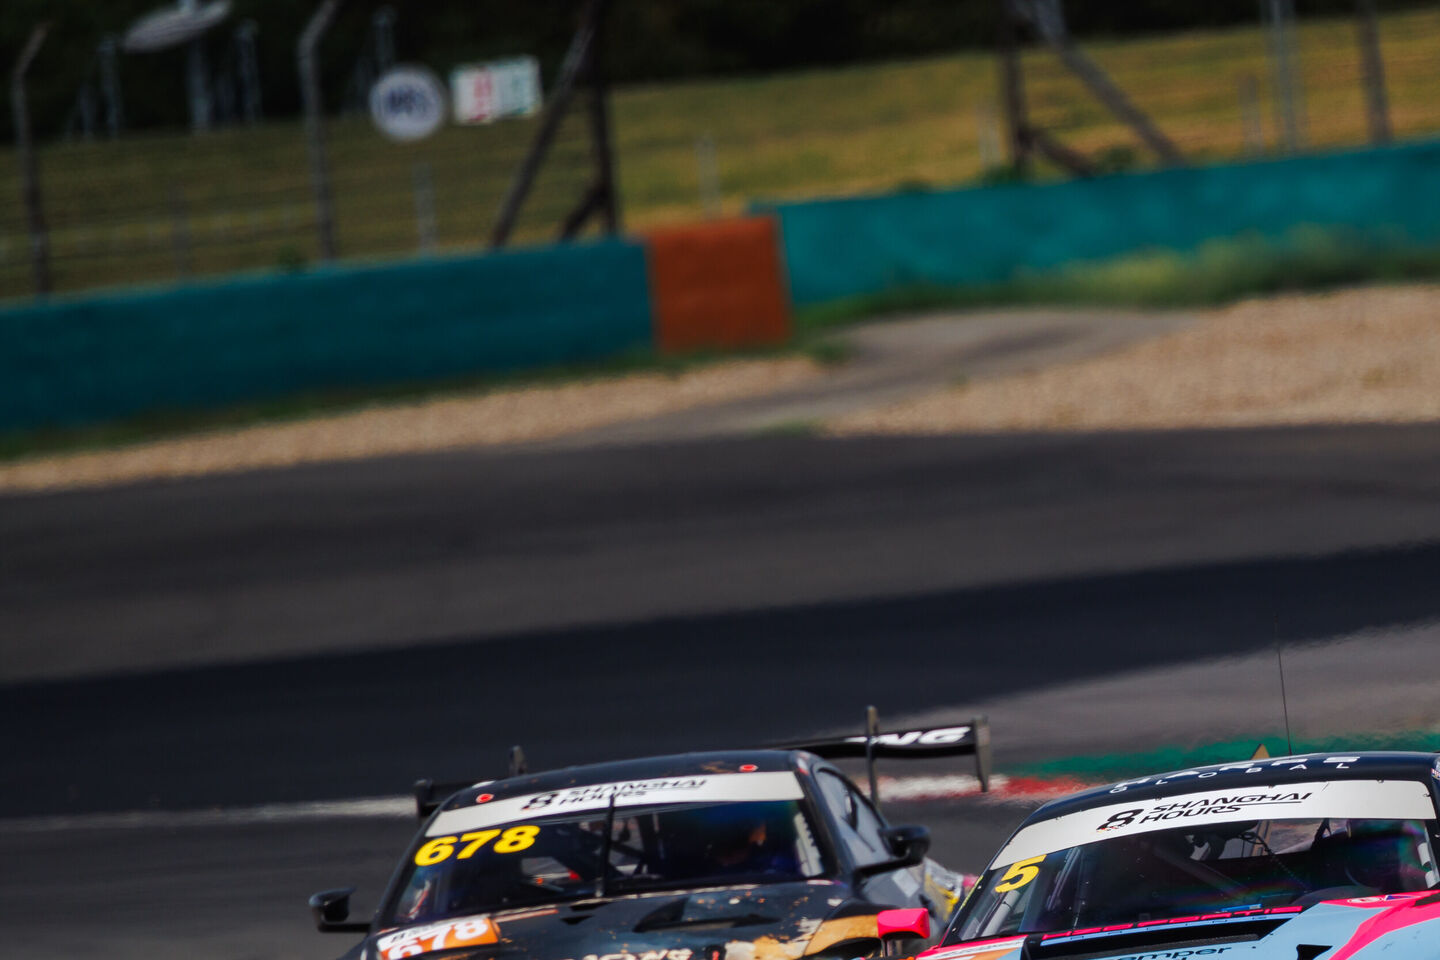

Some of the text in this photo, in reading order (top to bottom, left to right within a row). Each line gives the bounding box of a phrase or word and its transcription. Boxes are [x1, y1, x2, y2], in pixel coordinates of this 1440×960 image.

[521, 791, 556, 810] 8
[1151, 792, 1313, 813] SHANGHAI
[1096, 808, 1145, 831] 8
[1139, 804, 1243, 825] HOURS
[414, 825, 541, 867] 678
[995, 854, 1048, 893] 5
[387, 918, 490, 960] 678
